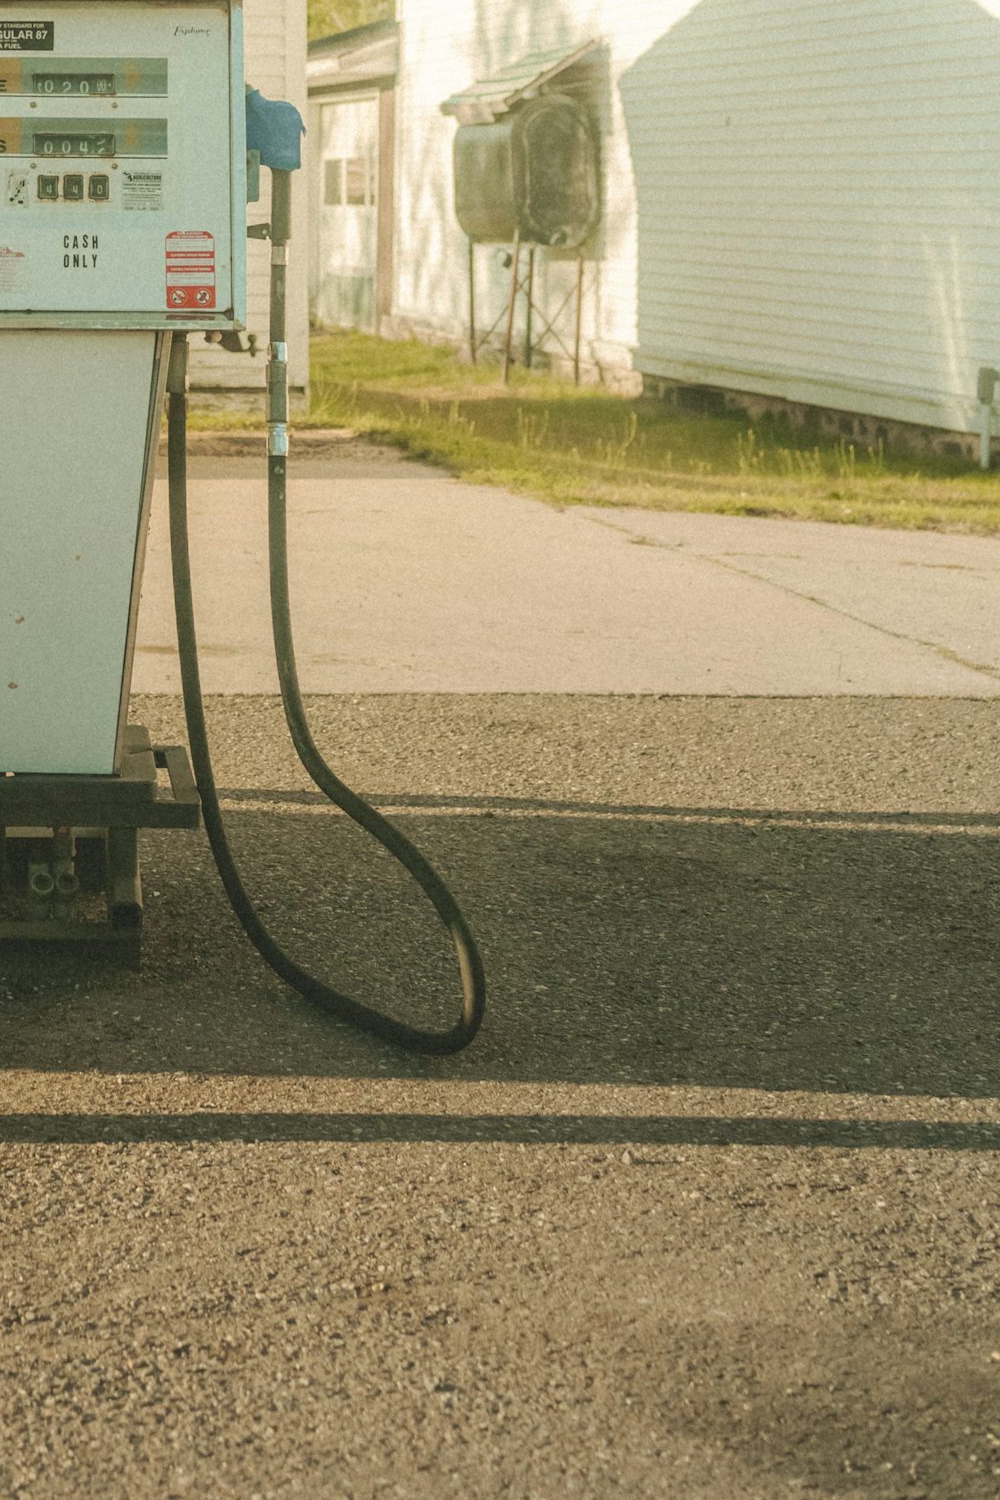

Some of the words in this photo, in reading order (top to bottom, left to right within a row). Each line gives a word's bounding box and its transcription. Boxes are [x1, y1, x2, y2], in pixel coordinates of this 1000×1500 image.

[36, 30, 48, 40] 87
[4, 42, 22, 50] FUEL
[63, 234, 99, 249] CASH
[63, 254, 98, 268] ONLY
